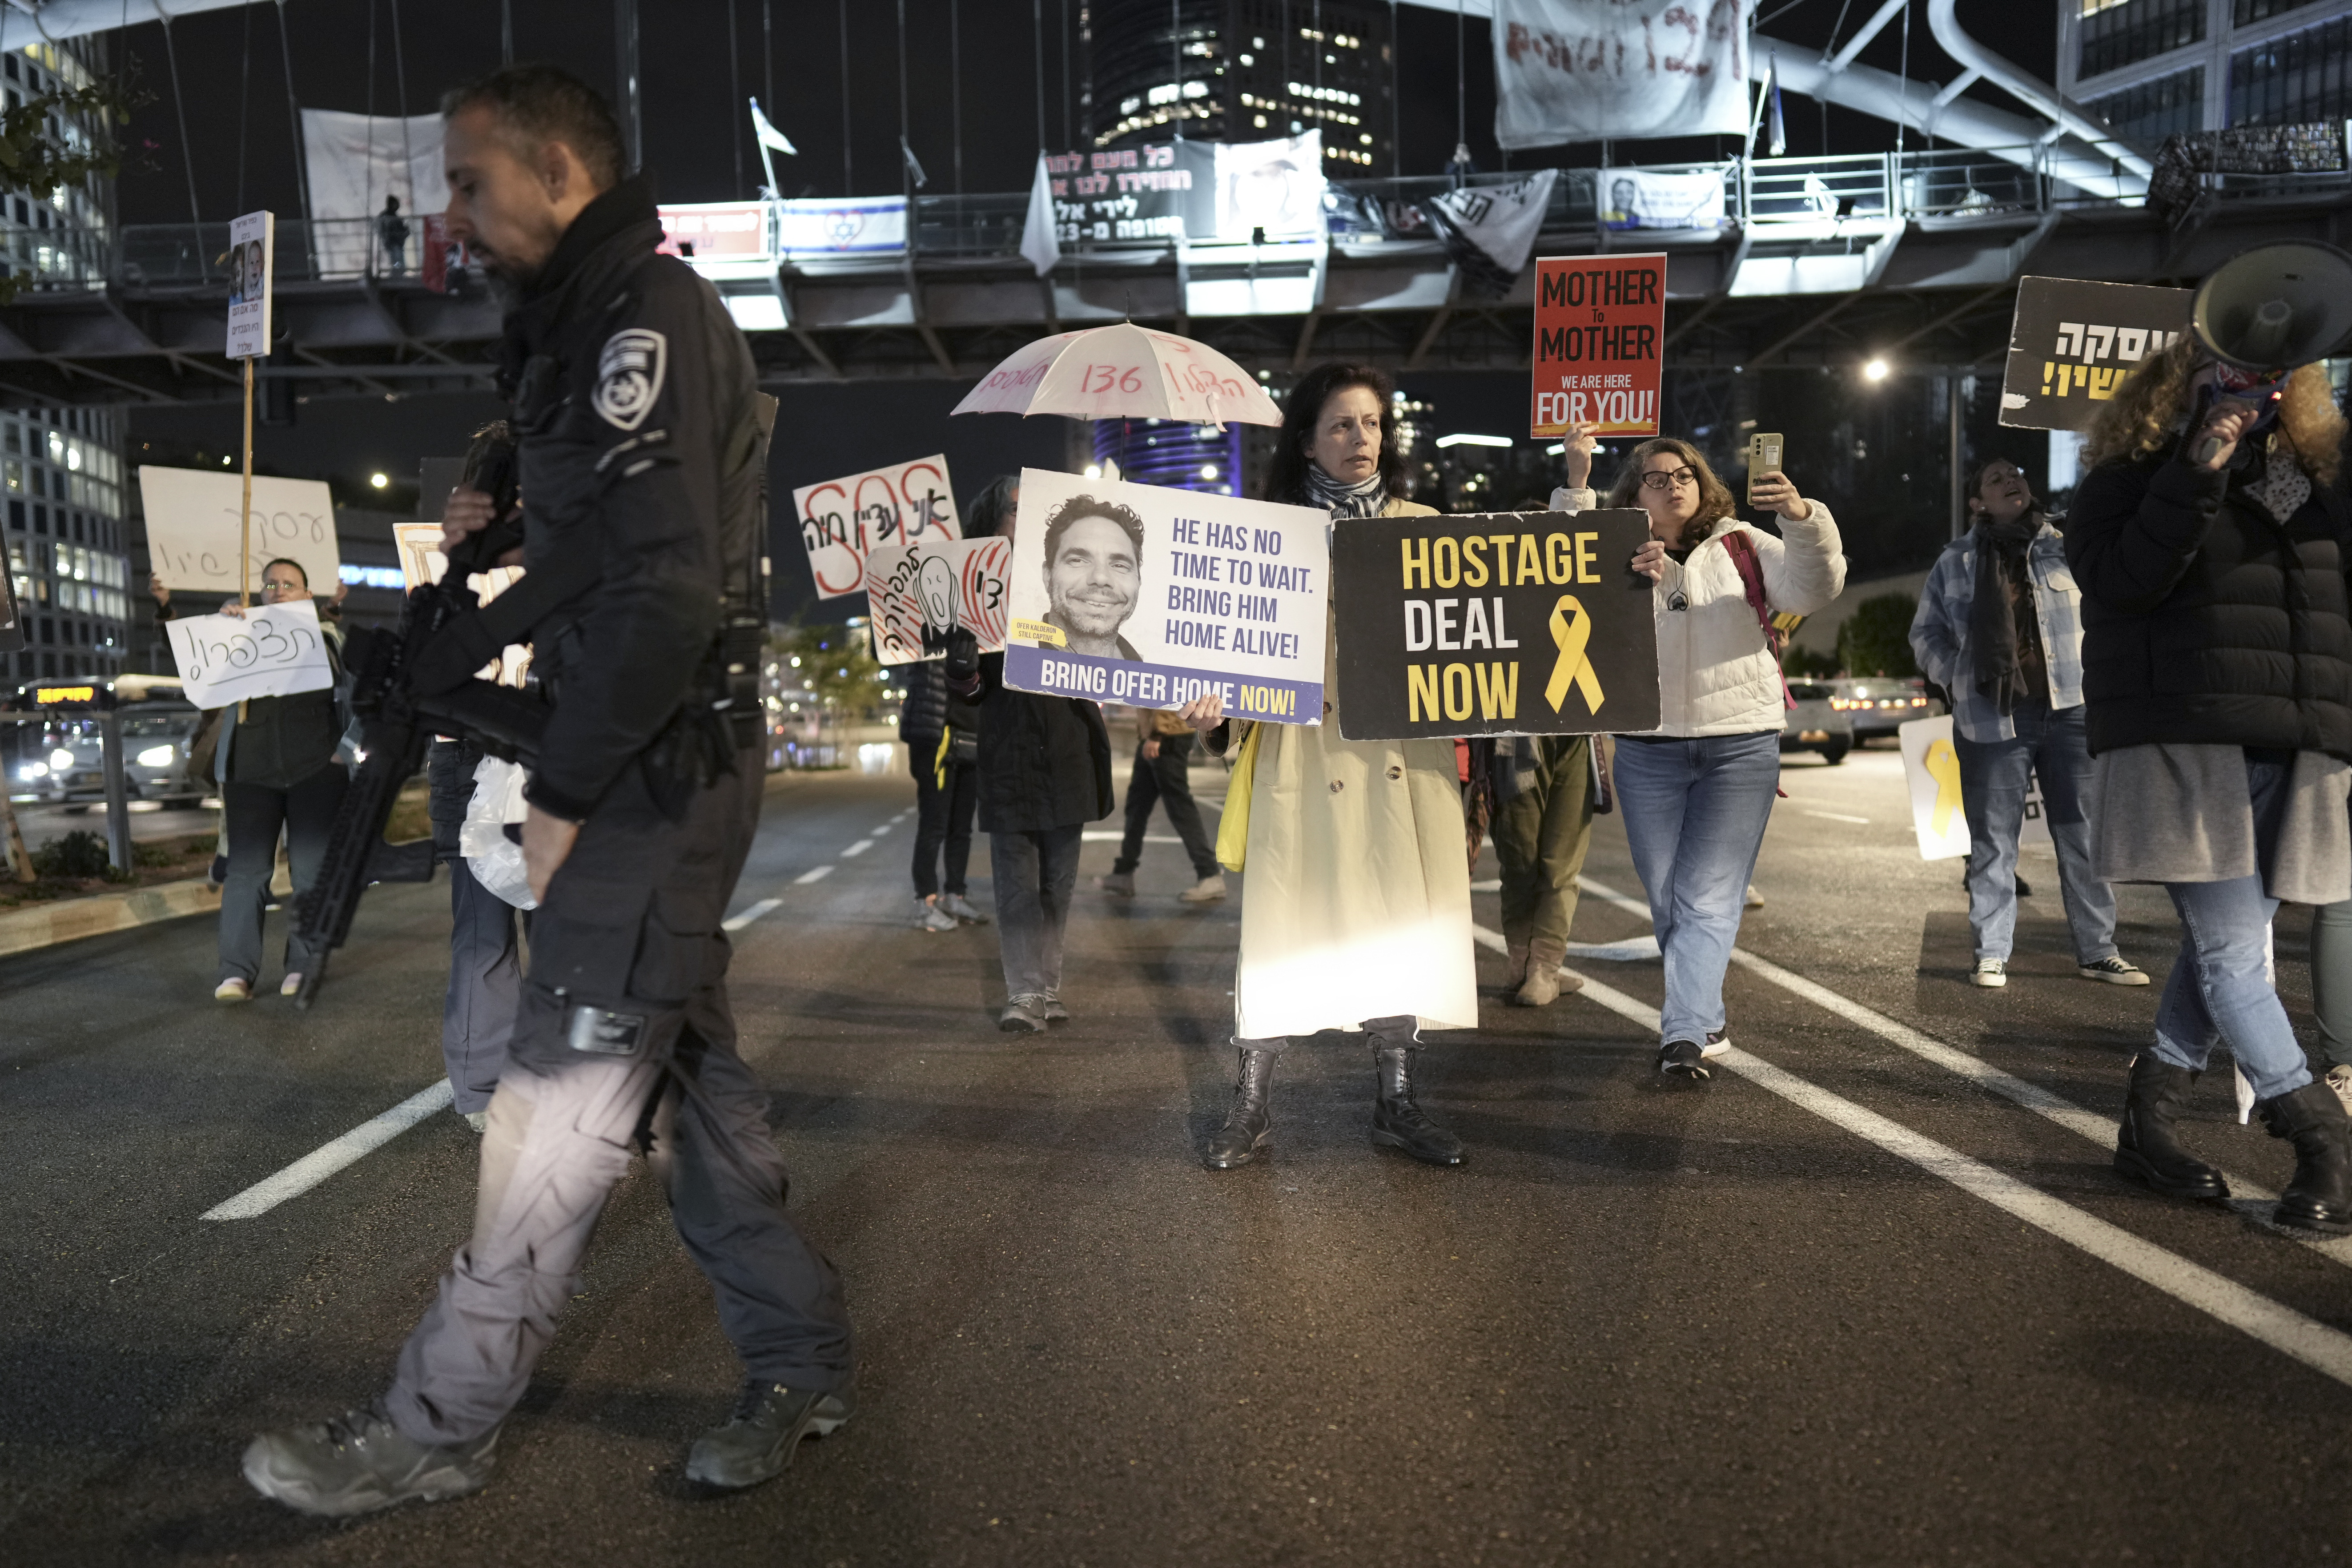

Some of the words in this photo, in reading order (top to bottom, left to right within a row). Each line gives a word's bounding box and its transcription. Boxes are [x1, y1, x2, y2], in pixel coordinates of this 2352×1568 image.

[1091, 150, 1138, 169] העם
[1143, 144, 1174, 168] כל
[1075, 171, 1110, 194] לנו
[1056, 200, 1086, 221] אל
[1092, 194, 1138, 218] לירי
[1543, 269, 1657, 307] MOTHER
[1592, 309, 1604, 323] To
[1540, 325, 1655, 362] MOTHER
[1081, 364, 1142, 394] 136
[1164, 362, 1245, 401] הצילו!
[1562, 376, 1578, 389] WE
[1580, 375, 1602, 388] ARE
[1604, 374, 1632, 388] HERE
[1537, 391, 1587, 425] FOR
[1593, 390, 1654, 424] YOU!
[853, 502, 900, 550] עדיין
[907, 488, 950, 536] אני
[801, 512, 847, 551] חיה
[1173, 518, 1200, 545] HE
[1206, 522, 1248, 551] HAS
[1254, 529, 1282, 556] NO
[159, 543, 296, 581] כשיו!
[1171, 551, 1220, 581] TIME
[1227, 558, 1252, 585] TO
[1258, 563, 1314, 593] WAIT.
[1401, 531, 1601, 590] HOSTAGE
[1167, 585, 1231, 617] BRING
[1237, 595, 1278, 623] HIM
[1018, 631, 1032, 639] STILL
[1033, 633, 1053, 642] CAPTIVE
[1030, 624, 1057, 634] KALDERON
[1165, 619, 1225, 651] HOME
[1232, 627, 1299, 659] ALIVE!
[1404, 597, 1519, 651] DEAL
[1041, 659, 1106, 694] BRING
[1112, 668, 1166, 701] OFER
[1172, 676, 1234, 709] HOME
[1240, 684, 1296, 716] NOW!
[1407, 662, 1519, 722] NOW
